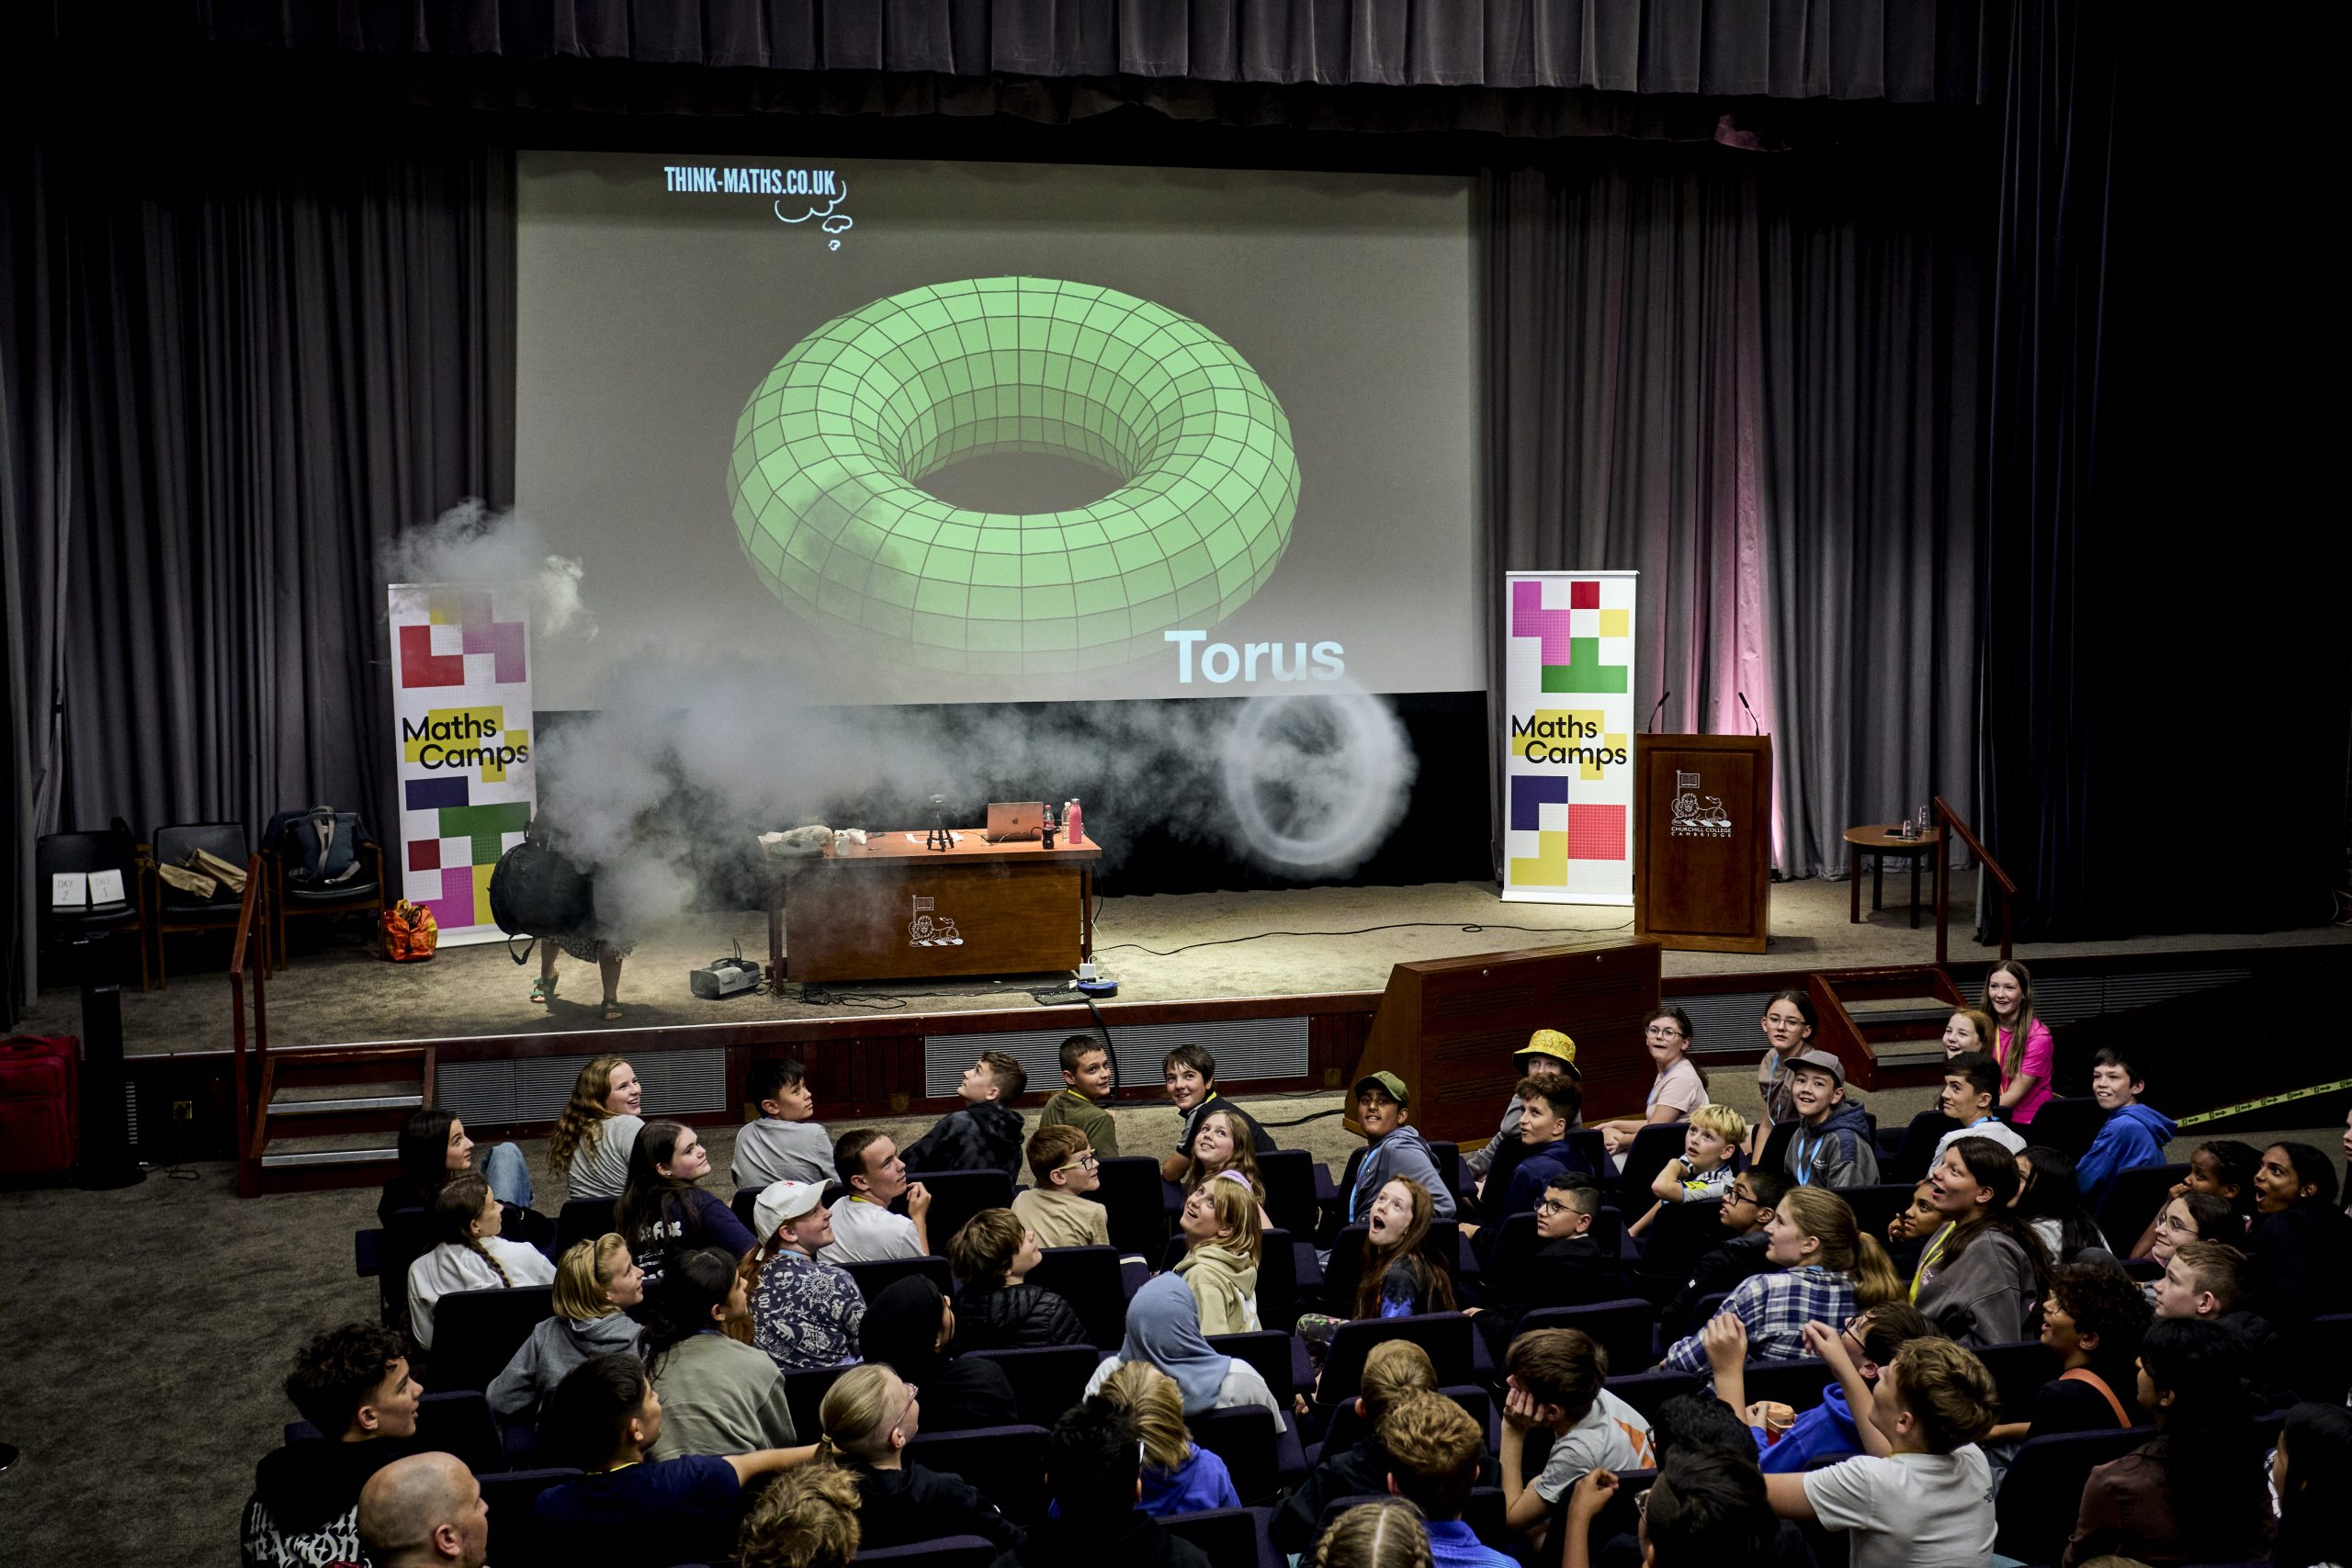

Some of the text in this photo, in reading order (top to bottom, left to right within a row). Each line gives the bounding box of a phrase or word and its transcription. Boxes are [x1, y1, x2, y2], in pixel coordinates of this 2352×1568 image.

[664, 166, 836, 195] THINK-MATHS.CO.UK
[1164, 630, 1345, 683] Torus
[402, 713, 497, 742] Maths
[1512, 715, 1598, 739] Maths
[420, 744, 529, 772] Camps
[1525, 740, 1627, 771] Camps
[58, 879, 73, 889] DAY
[62, 890, 69, 901] 2
[102, 886, 108, 897] 1
